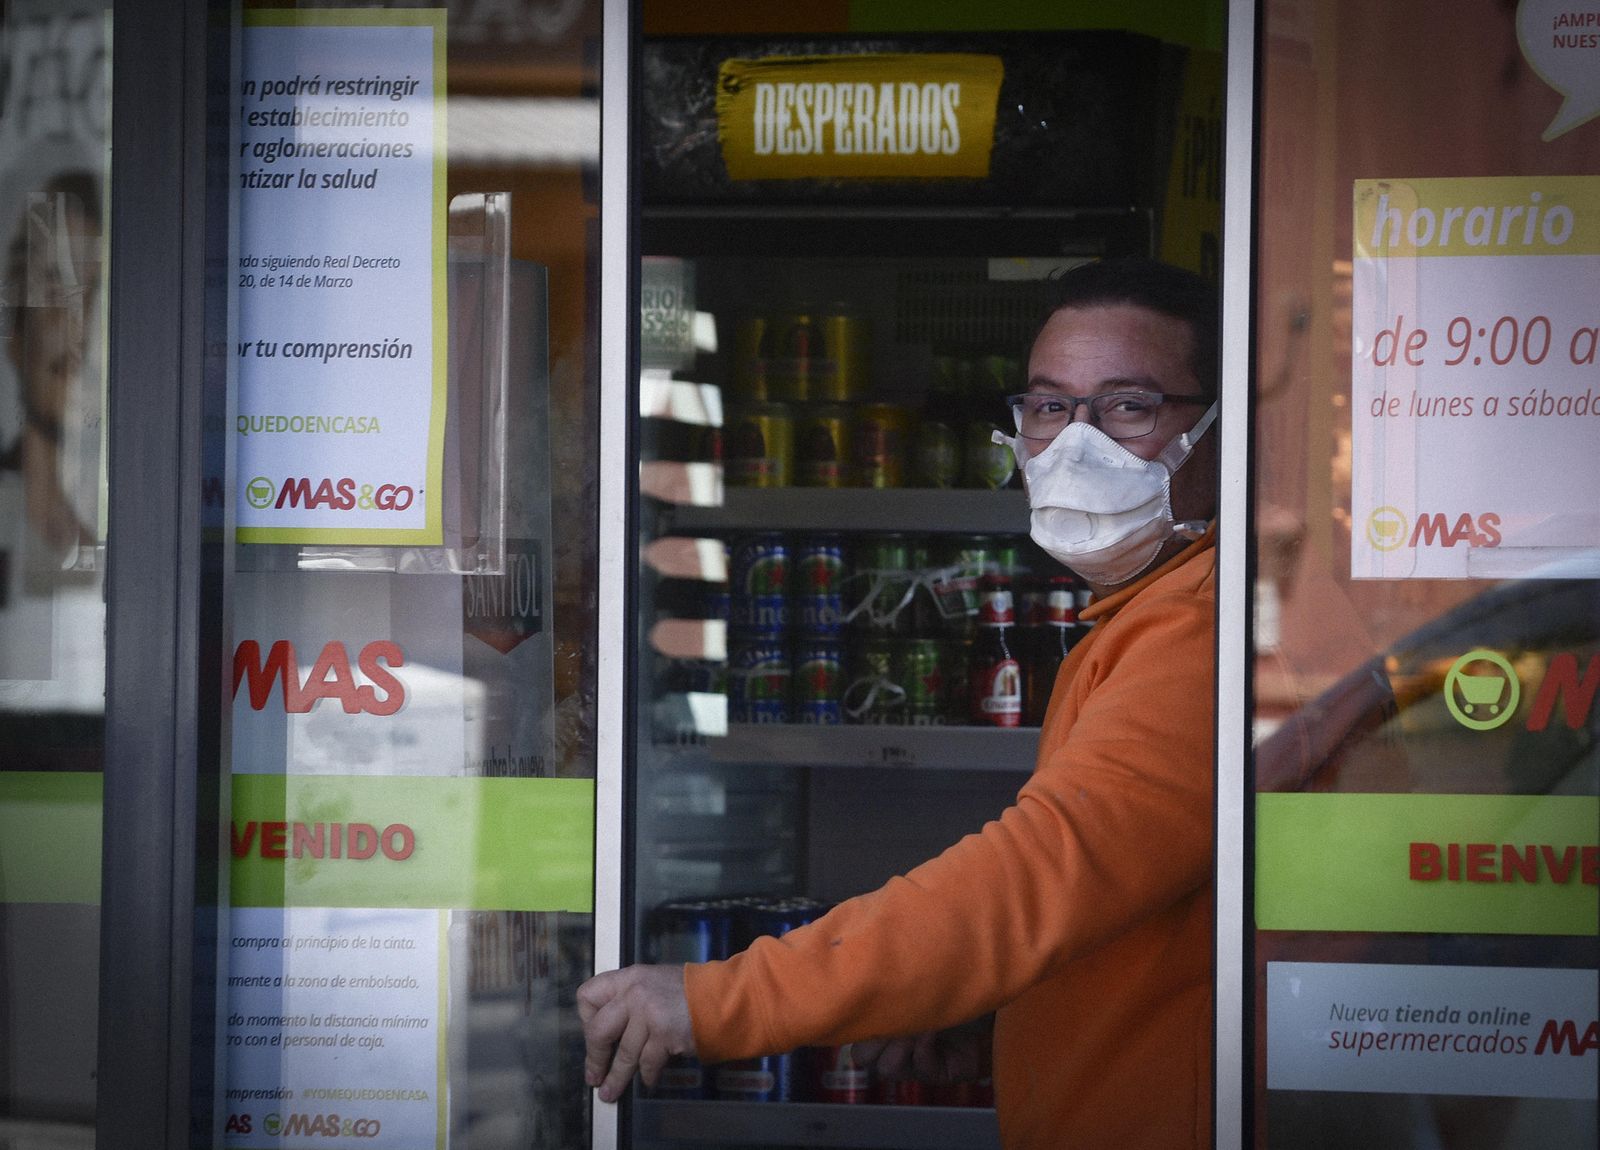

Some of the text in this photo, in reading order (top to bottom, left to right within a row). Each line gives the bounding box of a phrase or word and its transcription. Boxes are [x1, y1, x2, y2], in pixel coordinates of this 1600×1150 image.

[1553, 34, 1600, 49] NUES
[242, 75, 419, 101] n podrá restringir
[247, 105, 410, 127] establecimiento
[754, 82, 961, 155] DESPERADOS
[252, 137, 413, 163] aglomeraciones
[298, 168, 316, 190] la
[321, 168, 378, 190] salud
[1371, 191, 1575, 248] horario
[261, 254, 320, 272] siguiendo
[323, 254, 350, 269] Real
[353, 255, 401, 269] Decreto
[239, 273, 354, 289] 20, de 14 de Marzo
[256, 339, 277, 358] tu
[282, 337, 413, 364] comprensión
[1373, 315, 1600, 367] de 9:00 a
[1370, 391, 1401, 418] de
[1409, 389, 1474, 418] lunes
[1482, 396, 1499, 417] a
[236, 414, 381, 436] QUEDOENCASA
[275, 476, 414, 512] MAS&GO
[1408, 512, 1502, 548] MAS
[233, 639, 406, 716] MAS
[230, 820, 416, 862] VENIDO
[231, 934, 416, 951] compra al principio de la cinta.
[273, 977, 281, 988] a
[284, 974, 296, 988] la
[299, 977, 328, 989] zona
[331, 975, 347, 989] de
[349, 974, 420, 990] embolsado.
[247, 1015, 307, 1029] momento
[309, 1014, 321, 1028] la
[323, 1014, 379, 1029] distancia
[382, 1014, 429, 1030] mínima
[1329, 1003, 1531, 1027] Nueva tienda online
[245, 1034, 268, 1047] con
[270, 1032, 281, 1047] el
[282, 1033, 338, 1051] personal
[340, 1033, 355, 1048] de
[358, 1034, 385, 1051] caja.
[1328, 1029, 1528, 1057] supermercados
[284, 1113, 381, 1137] MAS&GO
